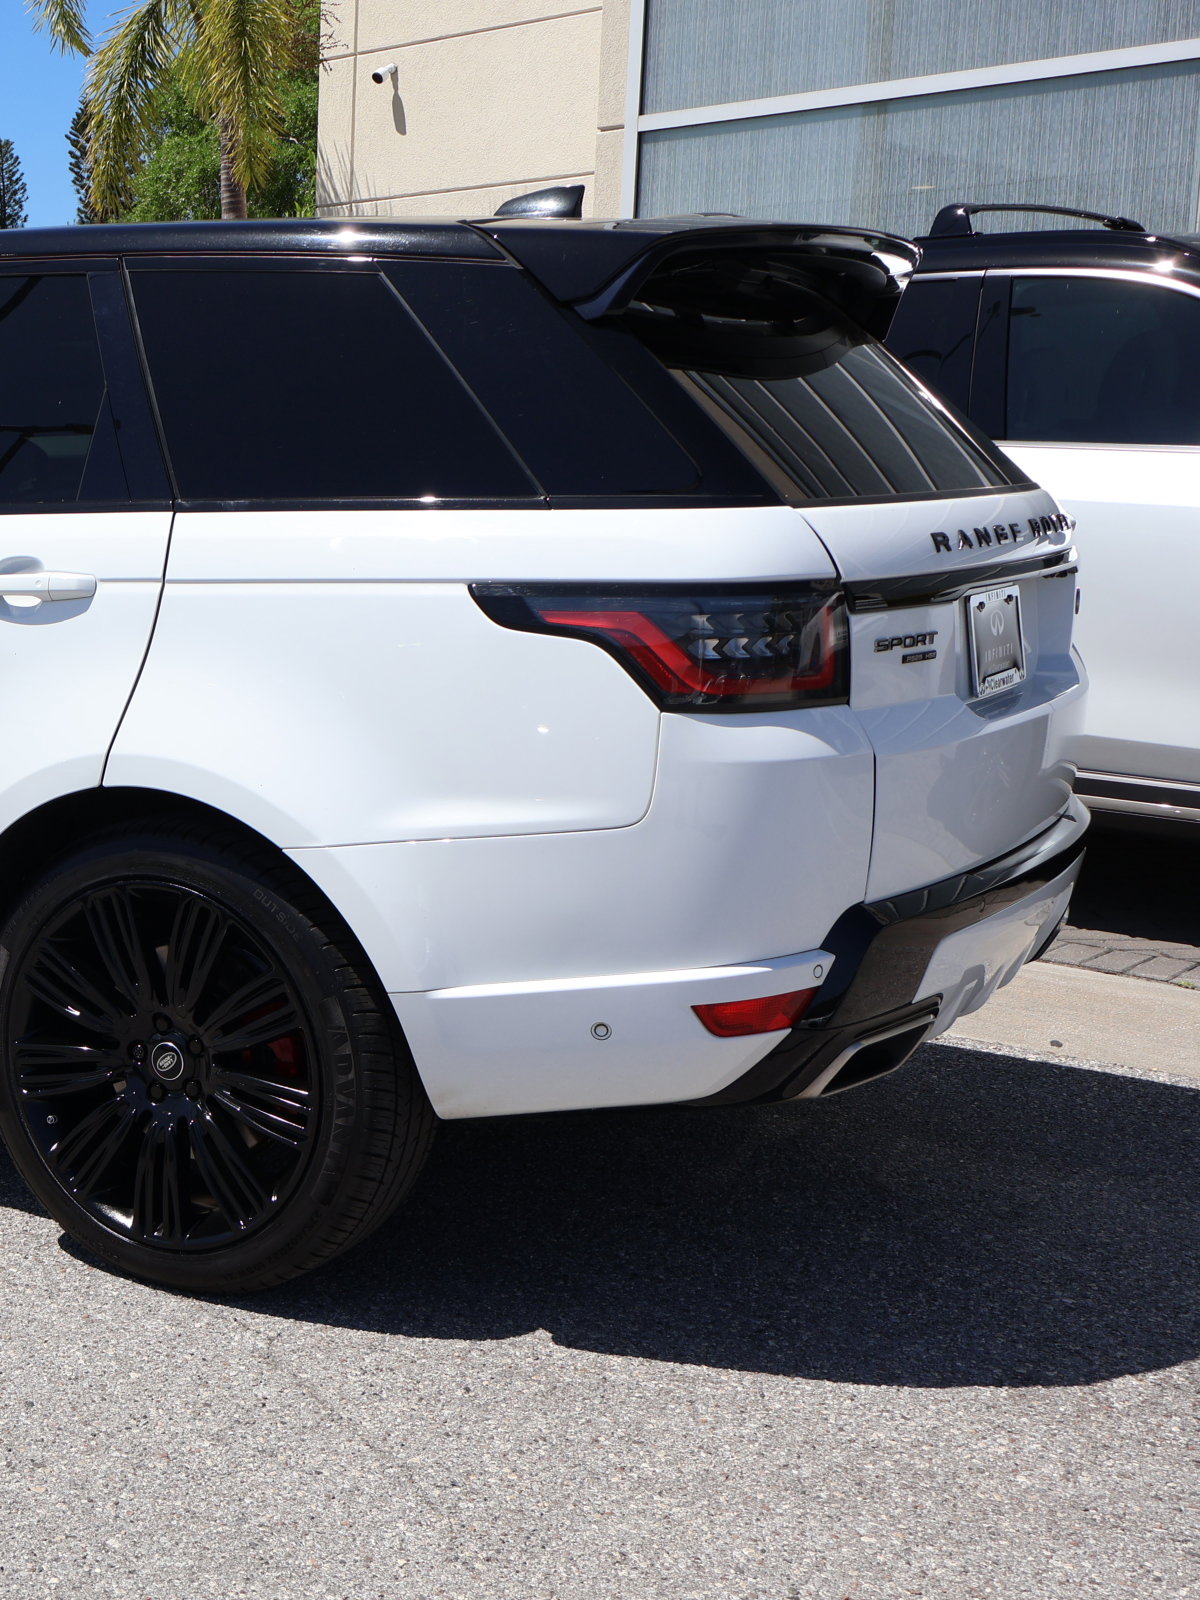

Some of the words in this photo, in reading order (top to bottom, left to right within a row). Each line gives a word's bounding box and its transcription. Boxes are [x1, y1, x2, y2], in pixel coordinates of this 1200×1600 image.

[930, 522, 1024, 553] RANGE
[985, 589, 1007, 603] INFINITI
[873, 630, 939, 653] SPORT
[985, 643, 1013, 662] INFINITI
